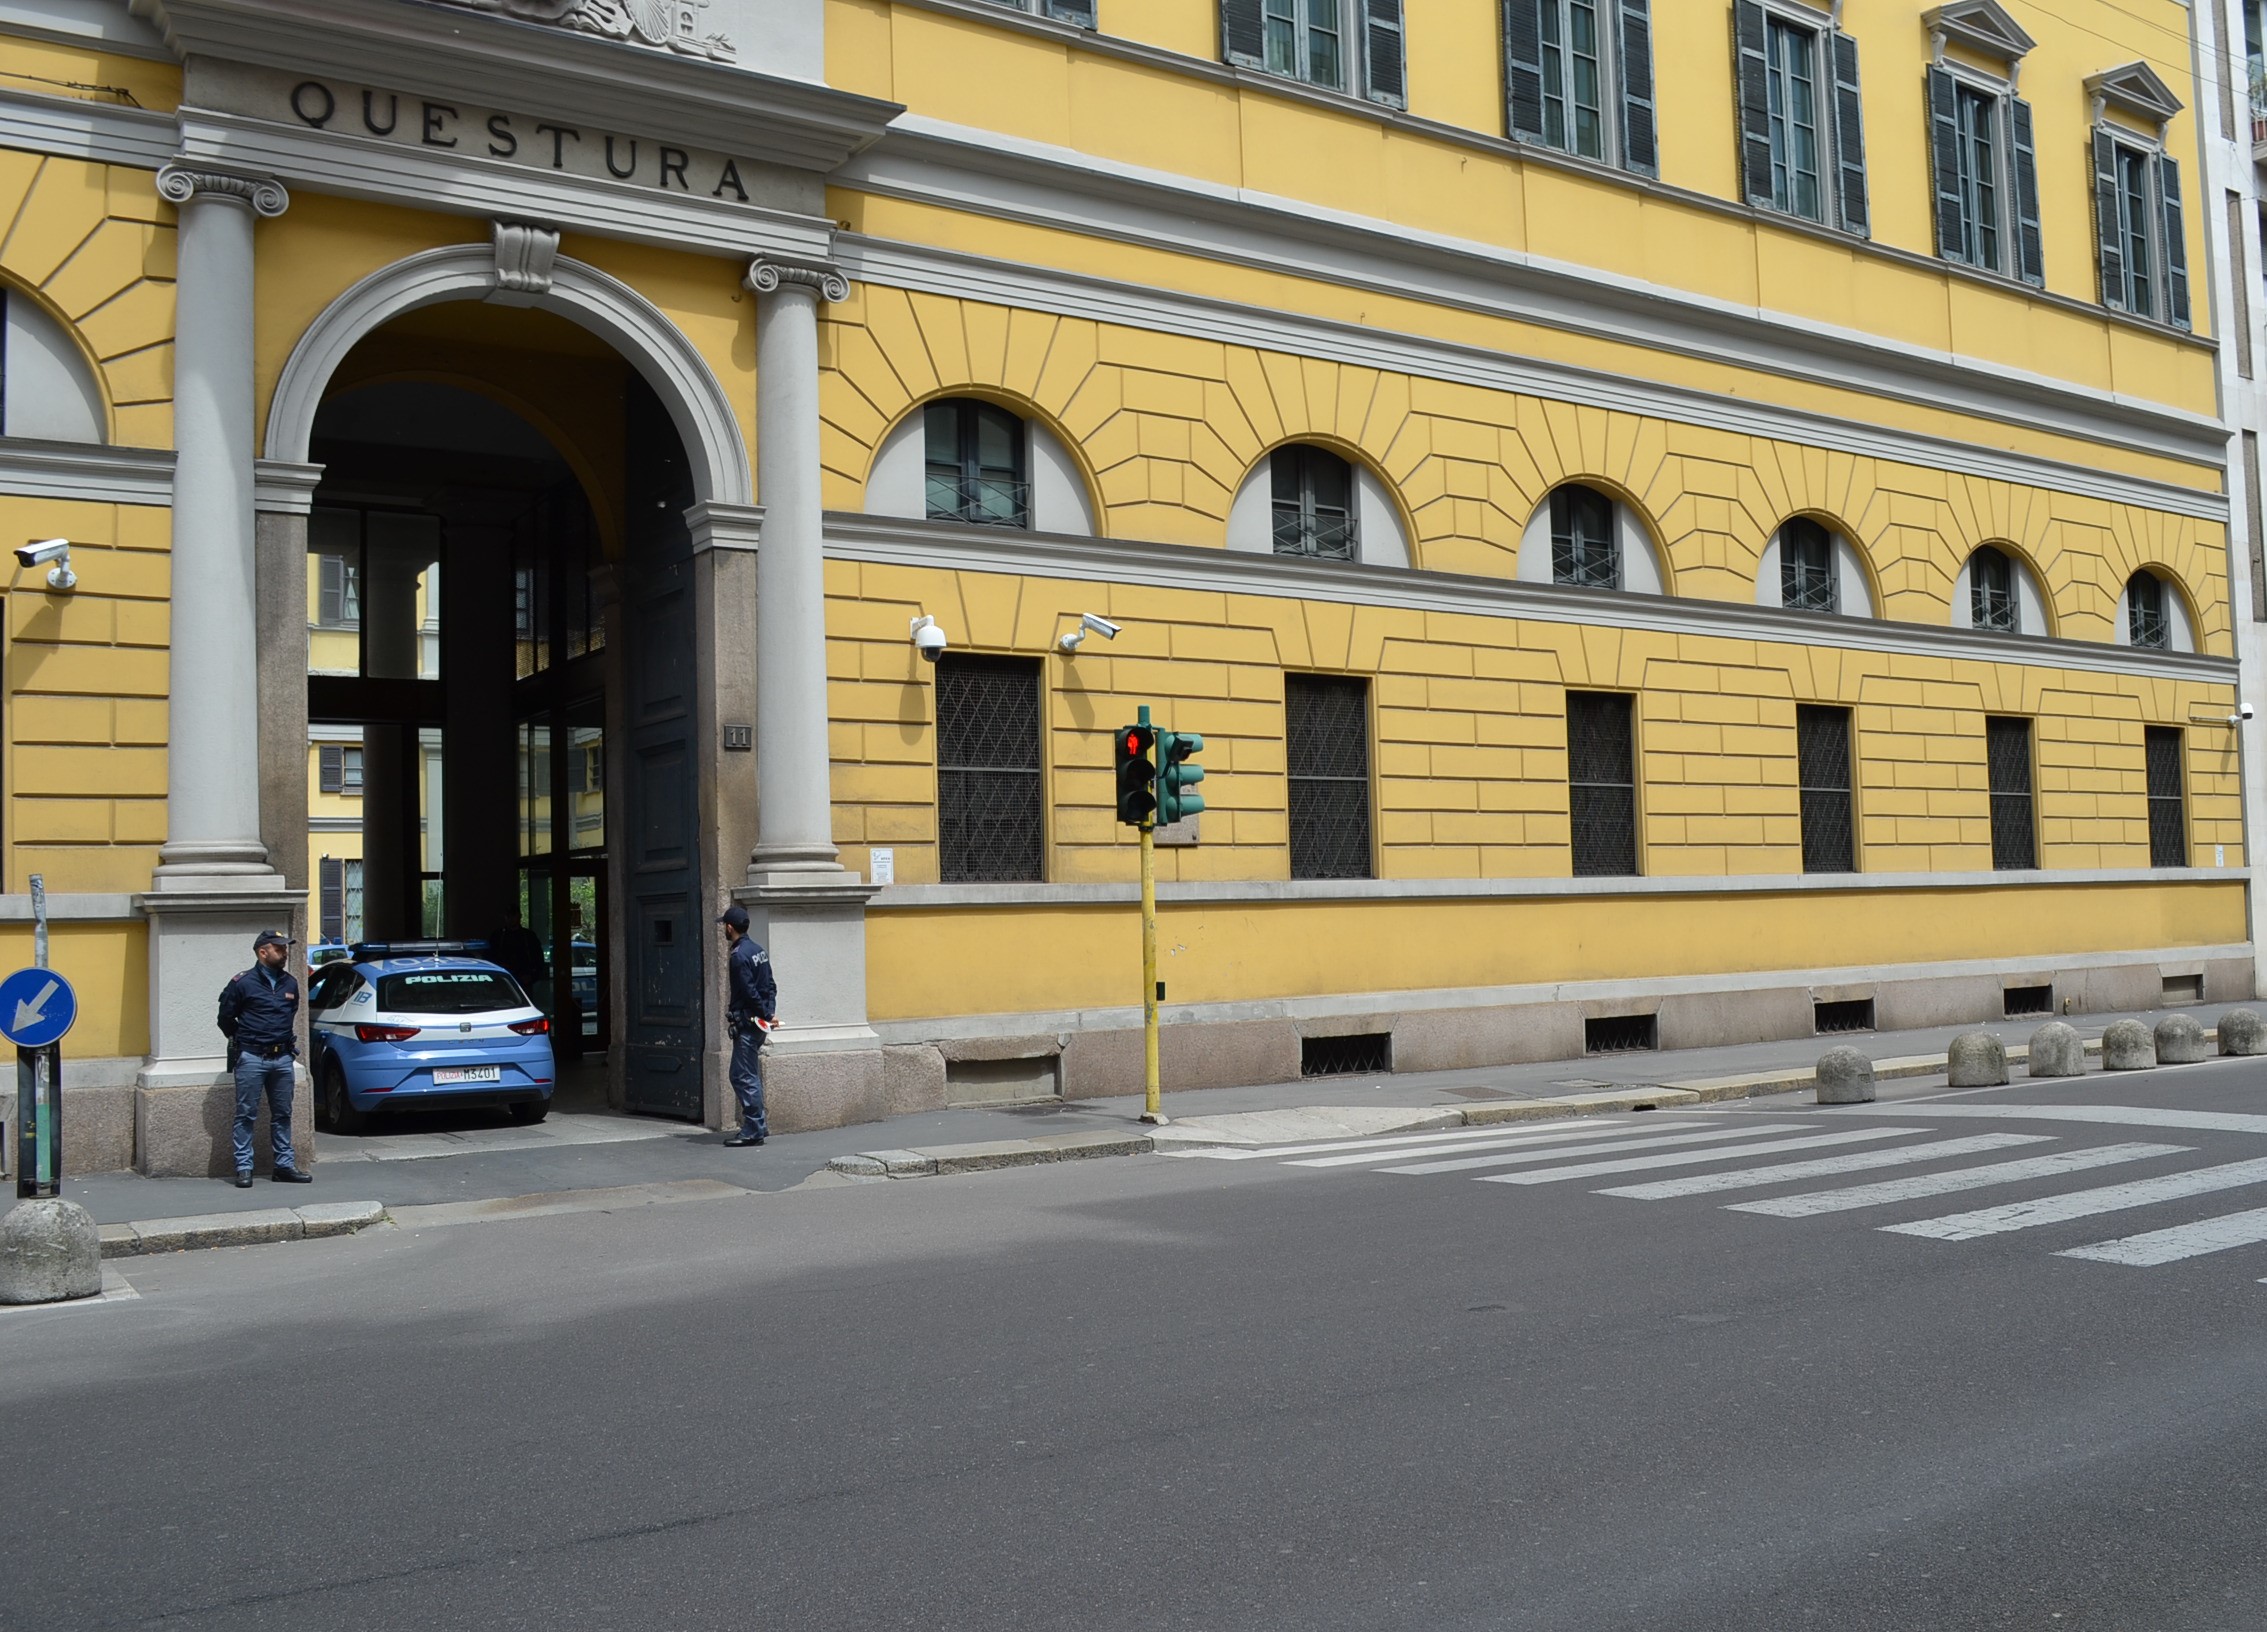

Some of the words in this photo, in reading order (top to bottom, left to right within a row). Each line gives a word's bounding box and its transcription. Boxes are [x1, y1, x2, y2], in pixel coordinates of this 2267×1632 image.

[291, 81, 749, 200] QUESTURA
[731, 728, 746, 746] 11
[405, 974, 494, 985] POLIZIA
[463, 1066, 496, 1080] M3401
